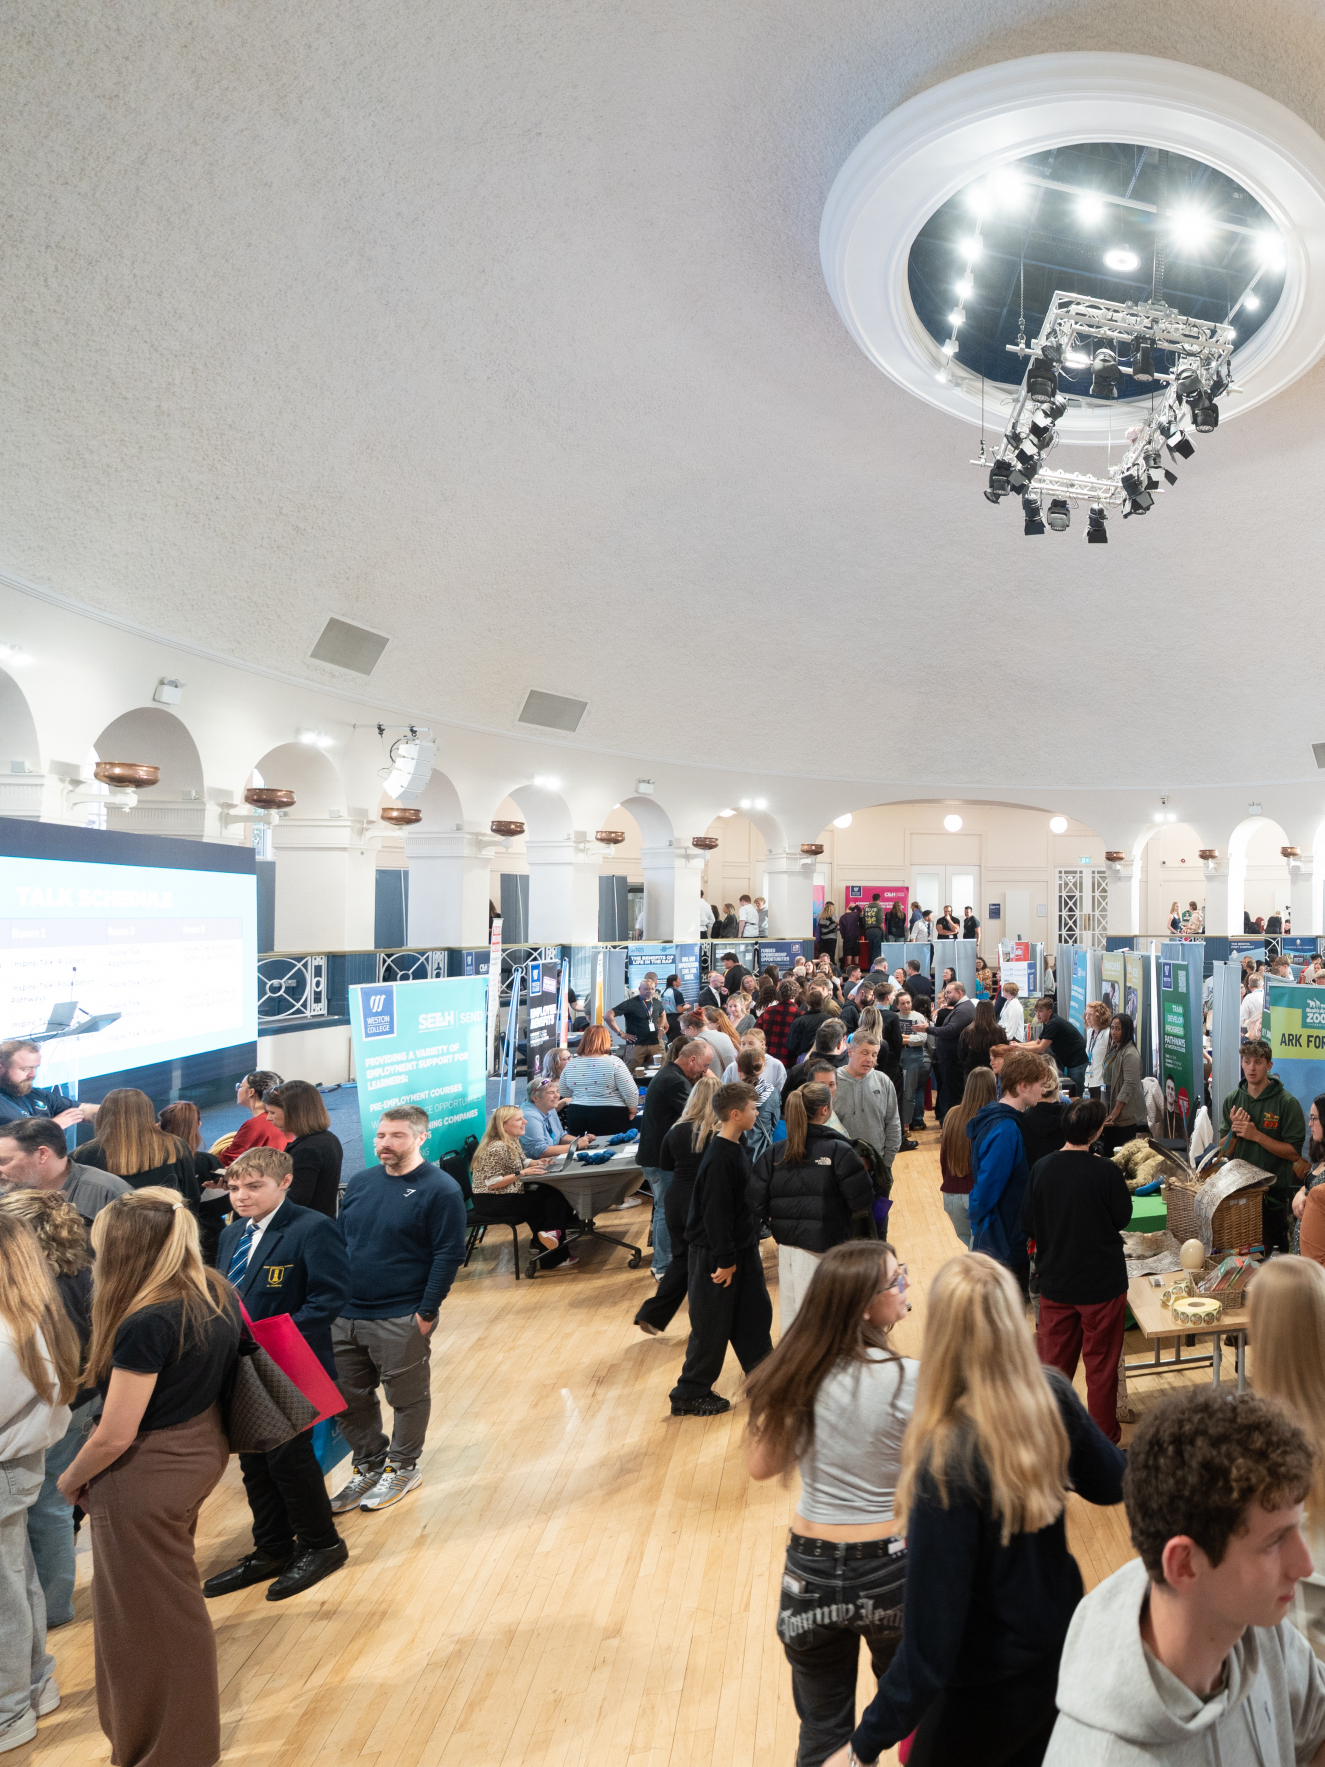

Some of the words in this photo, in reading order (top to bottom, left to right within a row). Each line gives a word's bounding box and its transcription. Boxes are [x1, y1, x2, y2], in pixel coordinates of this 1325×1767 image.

[15, 887, 74, 907] TALK
[78, 889, 174, 909] SCHEDULE
[1172, 1005, 1183, 1013] TRAIN
[367, 1015, 390, 1025] WESTON
[460, 1011, 483, 1024] SEND
[1167, 1014, 1183, 1024] DEVELOP
[367, 1025, 390, 1034] COLLEGE
[1165, 1035, 1186, 1048] PATHWAYS
[1280, 1033, 1302, 1048] ARK
[365, 1051, 407, 1067] PROVIDING
[408, 1051, 415, 1059] A
[415, 1044, 447, 1058] VARIETY
[448, 1043, 460, 1052] OF
[366, 1061, 418, 1079] EMPLOYMENT
[418, 1055, 454, 1069] SUPPORT
[454, 1052, 469, 1062] FOR
[367, 1074, 409, 1091] LEARNERS:
[370, 1091, 430, 1112] PRE-EMPLOYMENT
[430, 1084, 463, 1098] COURSES
[443, 1109, 478, 1126] COMPANIES
[777, 1603, 855, 1643] Tommy
